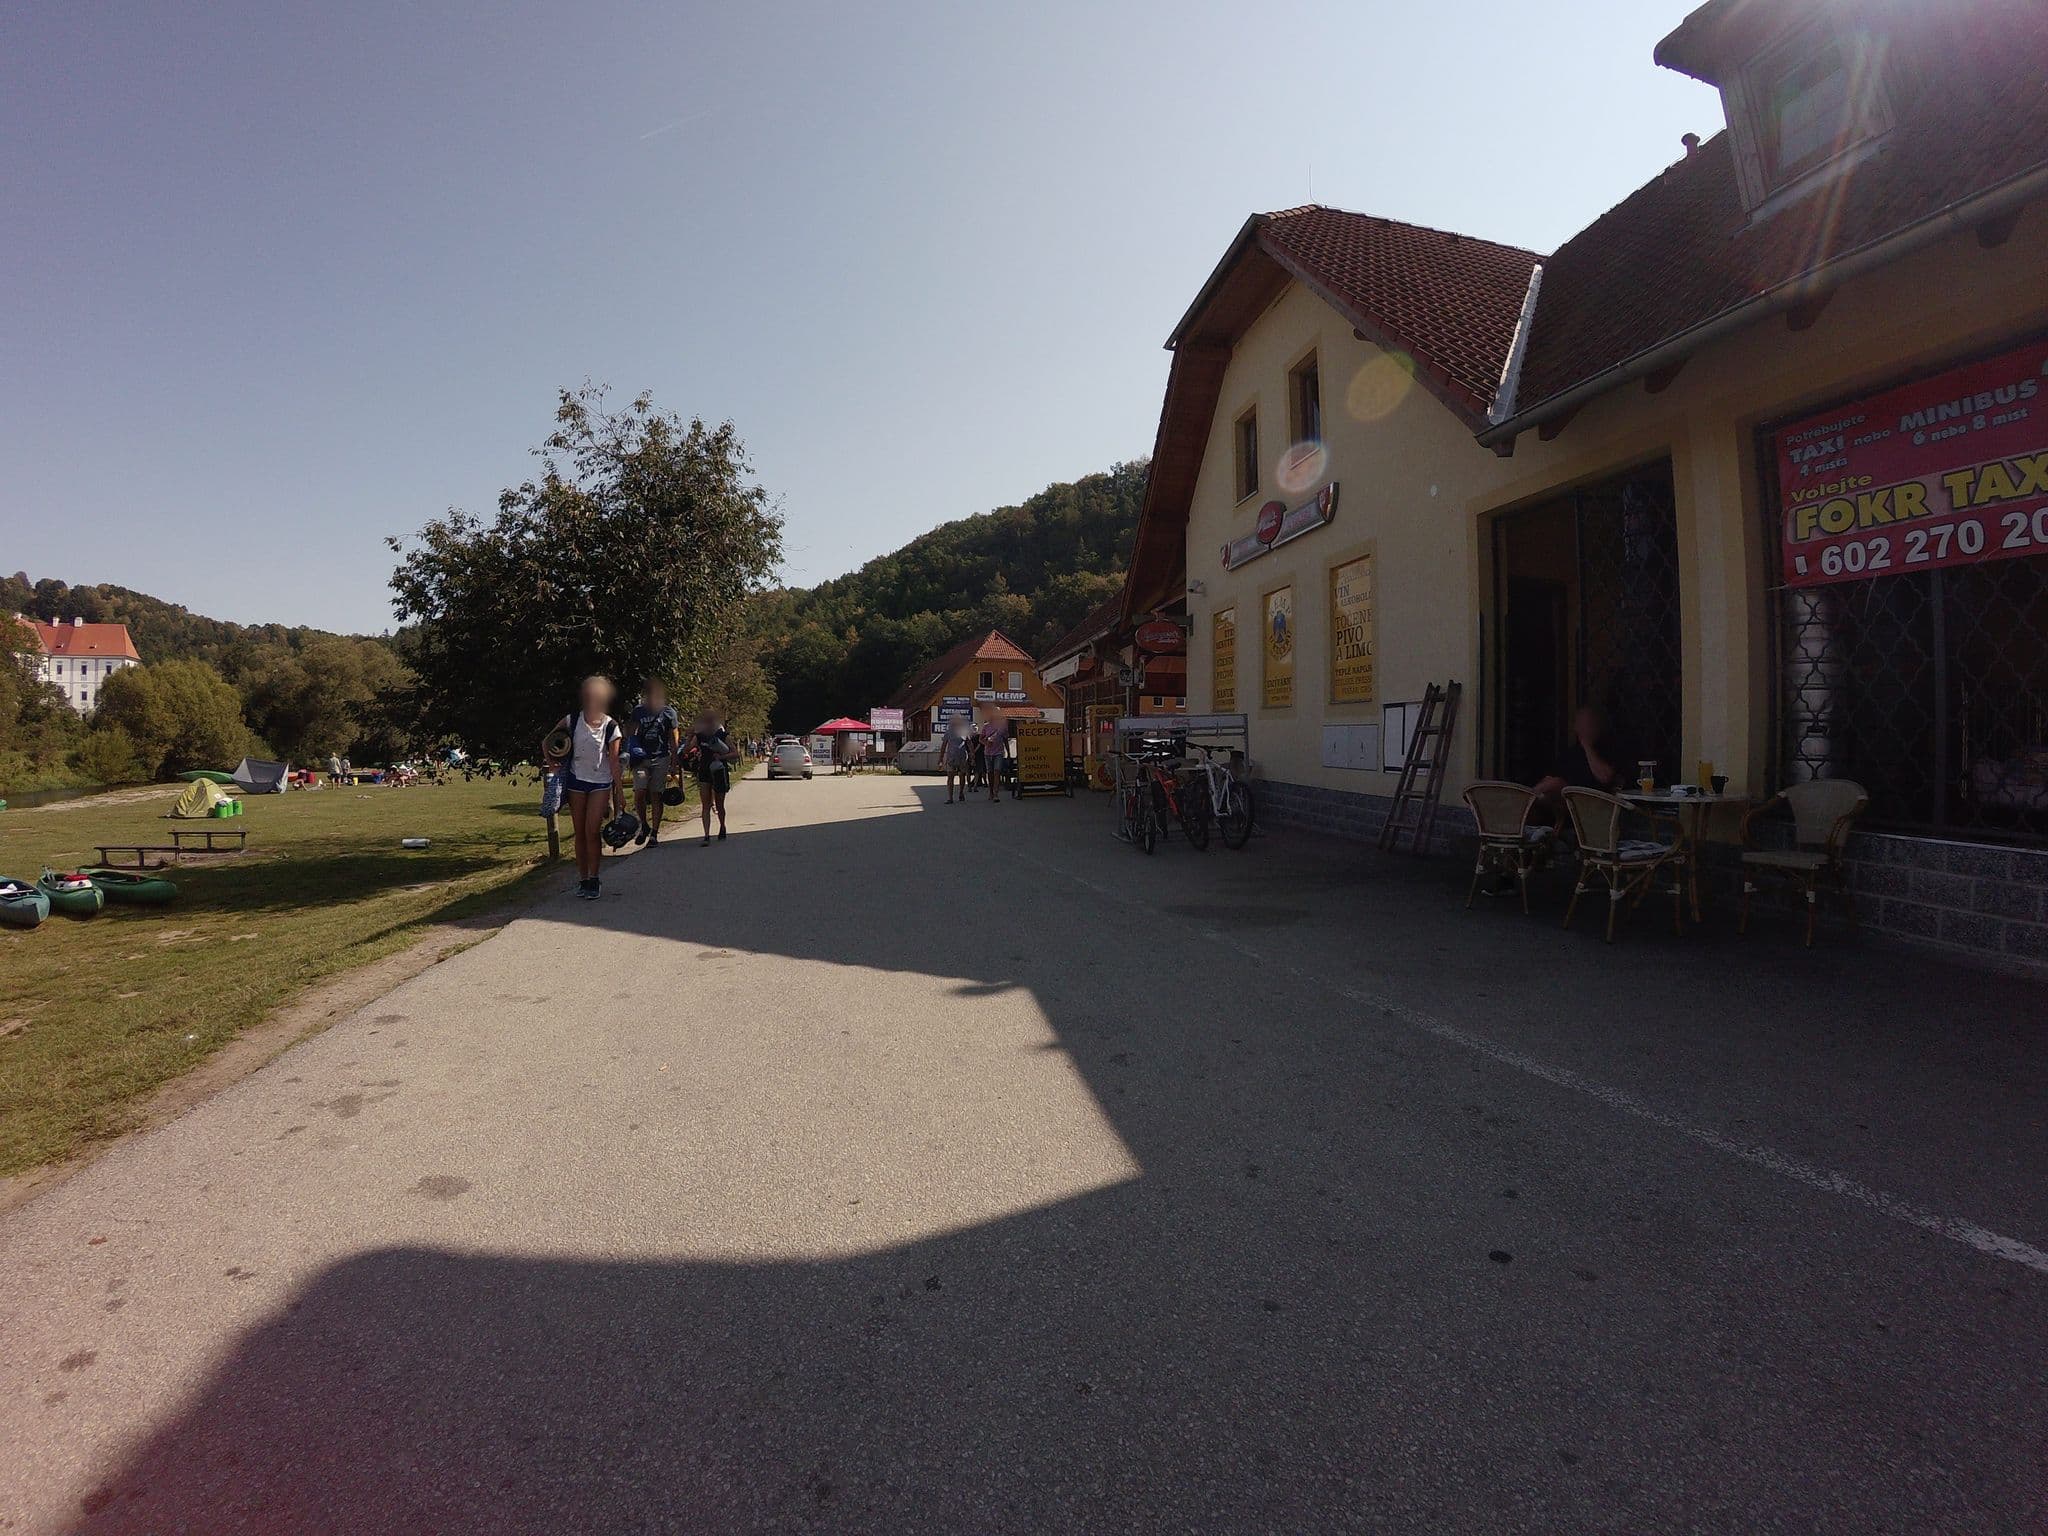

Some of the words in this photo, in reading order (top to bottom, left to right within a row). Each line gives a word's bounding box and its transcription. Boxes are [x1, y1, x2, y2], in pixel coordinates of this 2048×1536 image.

[1790, 435, 1844, 464] TAXI
[1854, 429, 1890, 446] nebo
[1899, 378, 2038, 432] MINIBUS
[1913, 430, 1925, 445] 6
[1931, 424, 1968, 441] nebo
[1972, 414, 1986, 430] 8
[1791, 474, 1873, 503] Volejte
[1796, 481, 1933, 540] FOKR
[1821, 536, 1891, 576] 602
[1904, 519, 1984, 564] 270
[1336, 625, 1364, 647] PIVO
[1017, 727, 1062, 736] RECEPCE
